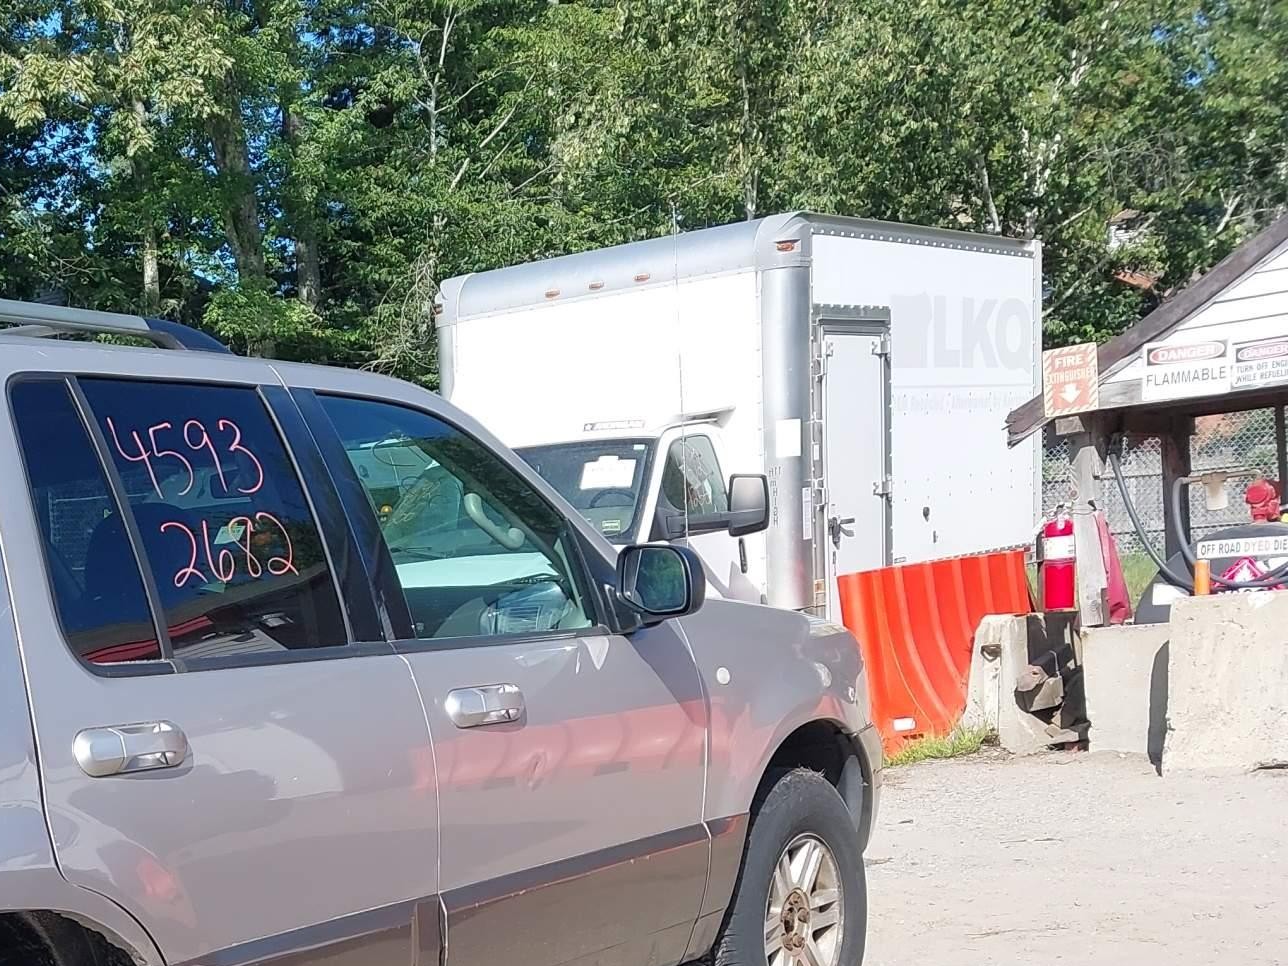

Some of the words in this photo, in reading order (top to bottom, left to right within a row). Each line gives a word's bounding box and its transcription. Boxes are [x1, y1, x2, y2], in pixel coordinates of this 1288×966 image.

[934, 296, 1033, 375] LKQ
[1055, 354, 1084, 369] FIRE
[1158, 345, 1218, 360] DANGER
[1257, 362, 1268, 371] OFF
[1146, 366, 1226, 387] FLAMMABLE
[107, 416, 264, 500] 4593
[160, 511, 299, 588] 2682
[1201, 544, 1216, 556] OFF
[1219, 541, 1241, 554] ROAD
[1244, 540, 1271, 553] DYED
